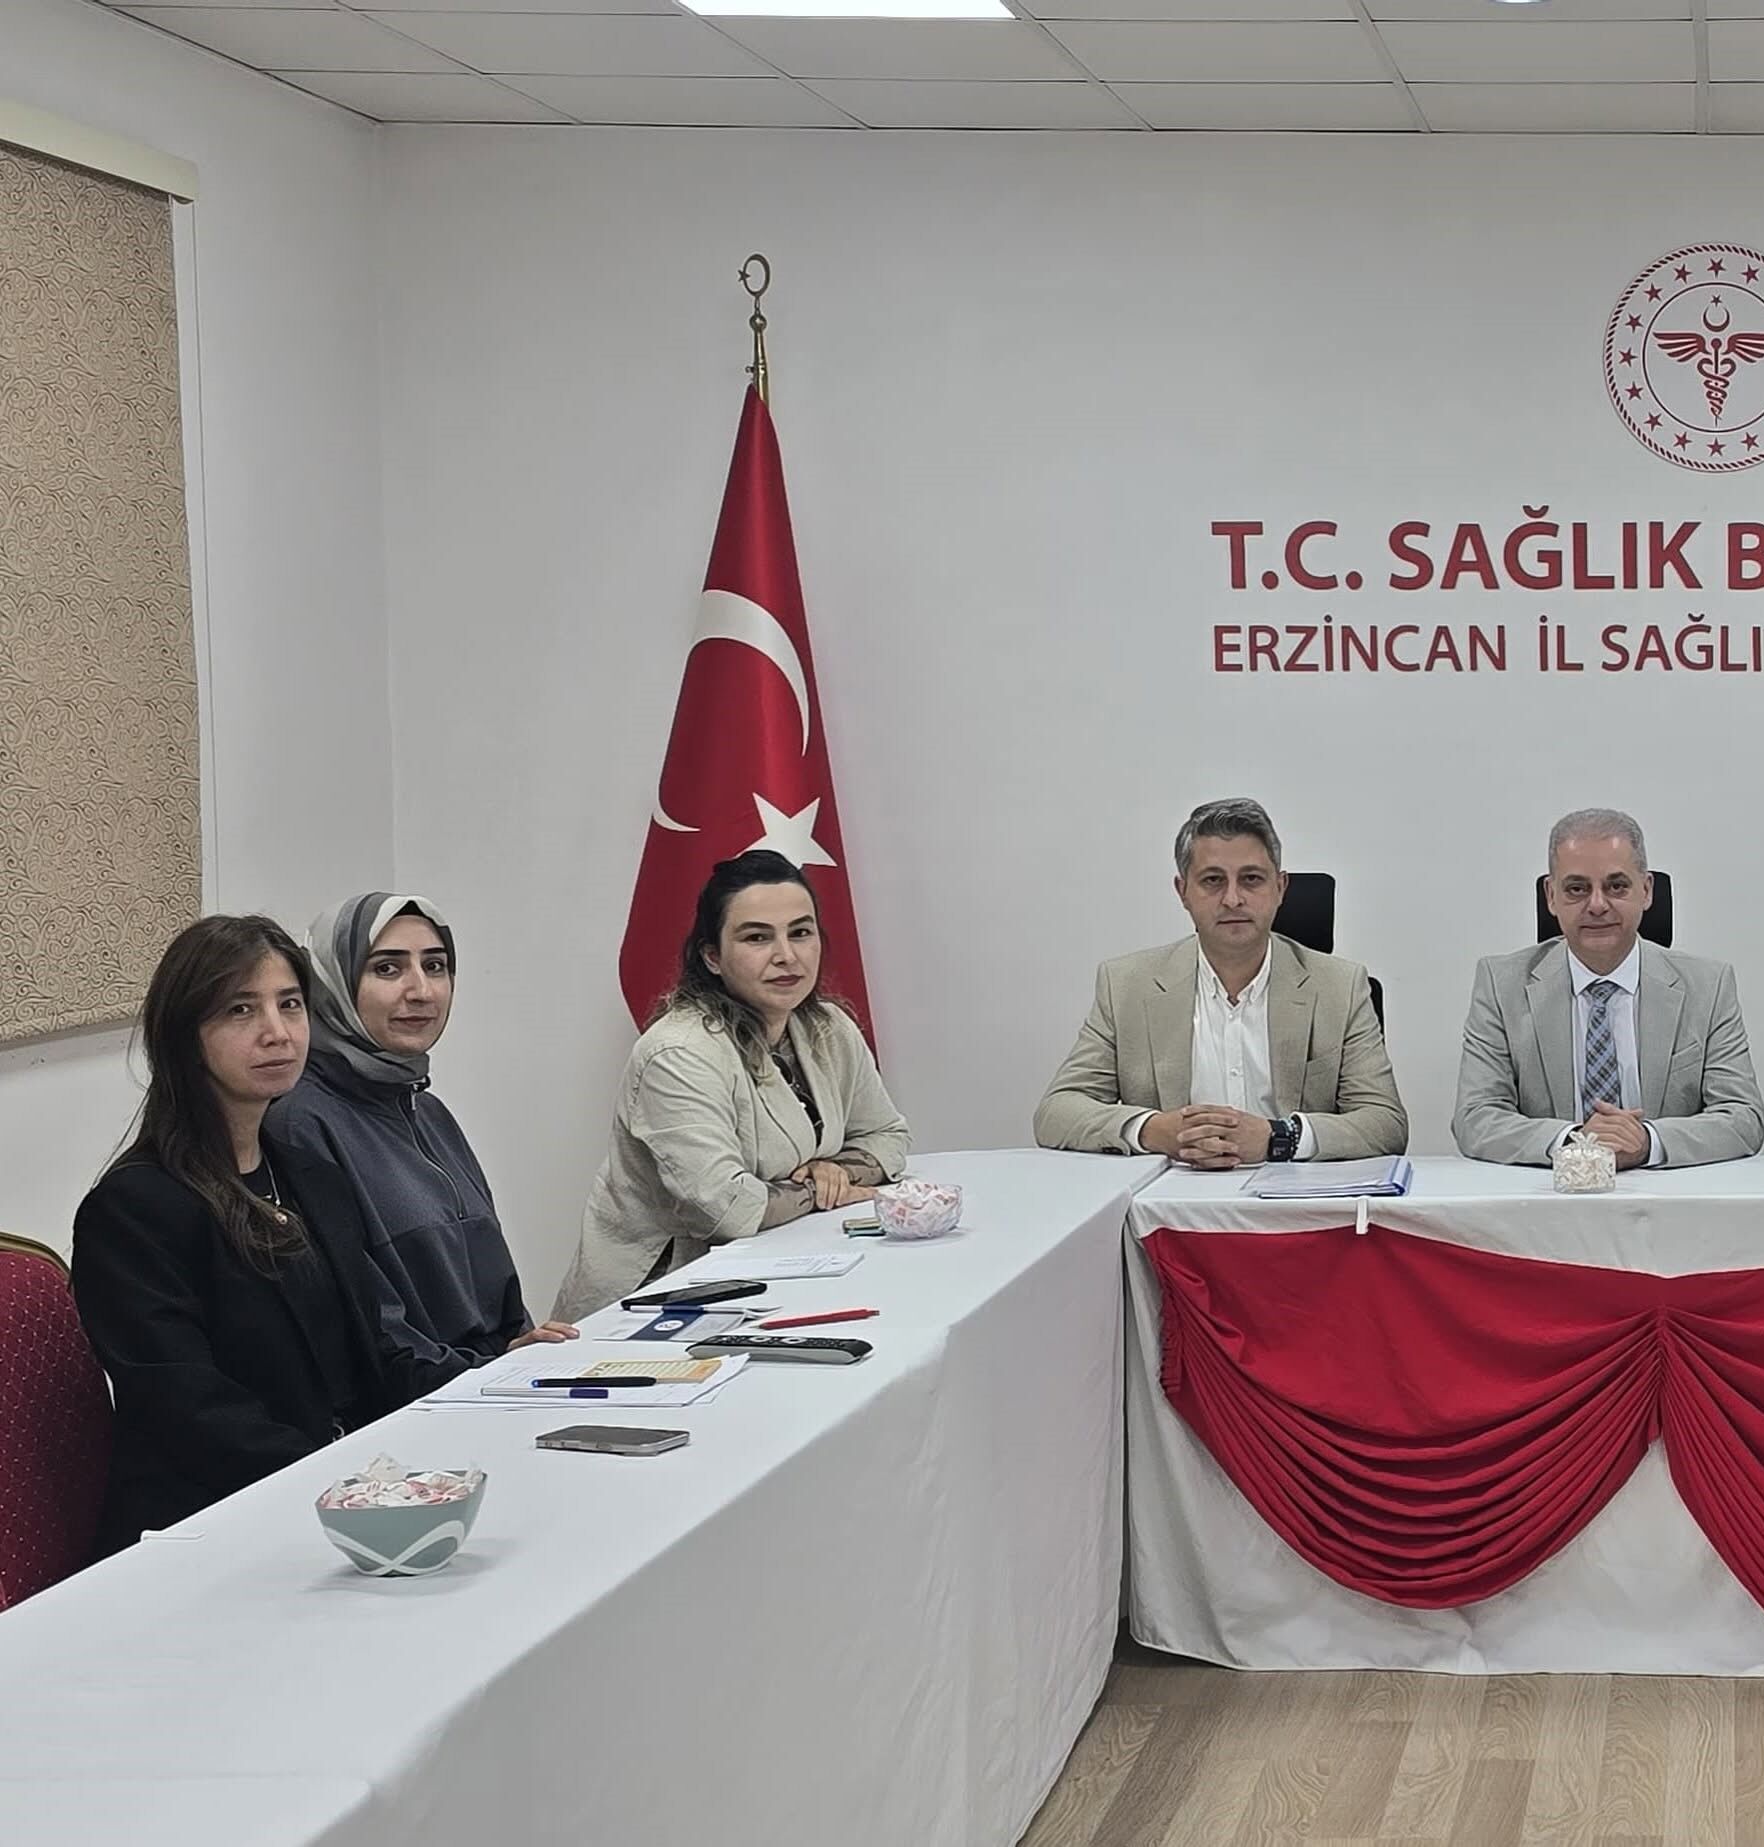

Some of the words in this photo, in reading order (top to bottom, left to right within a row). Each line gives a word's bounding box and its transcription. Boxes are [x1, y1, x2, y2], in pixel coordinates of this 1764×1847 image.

[1211, 520, 1363, 591] T.C.
[1387, 505, 1702, 591] SAĞLIK
[1213, 614, 1507, 673] ERZİNCAN
[1538, 614, 1584, 672] İL
